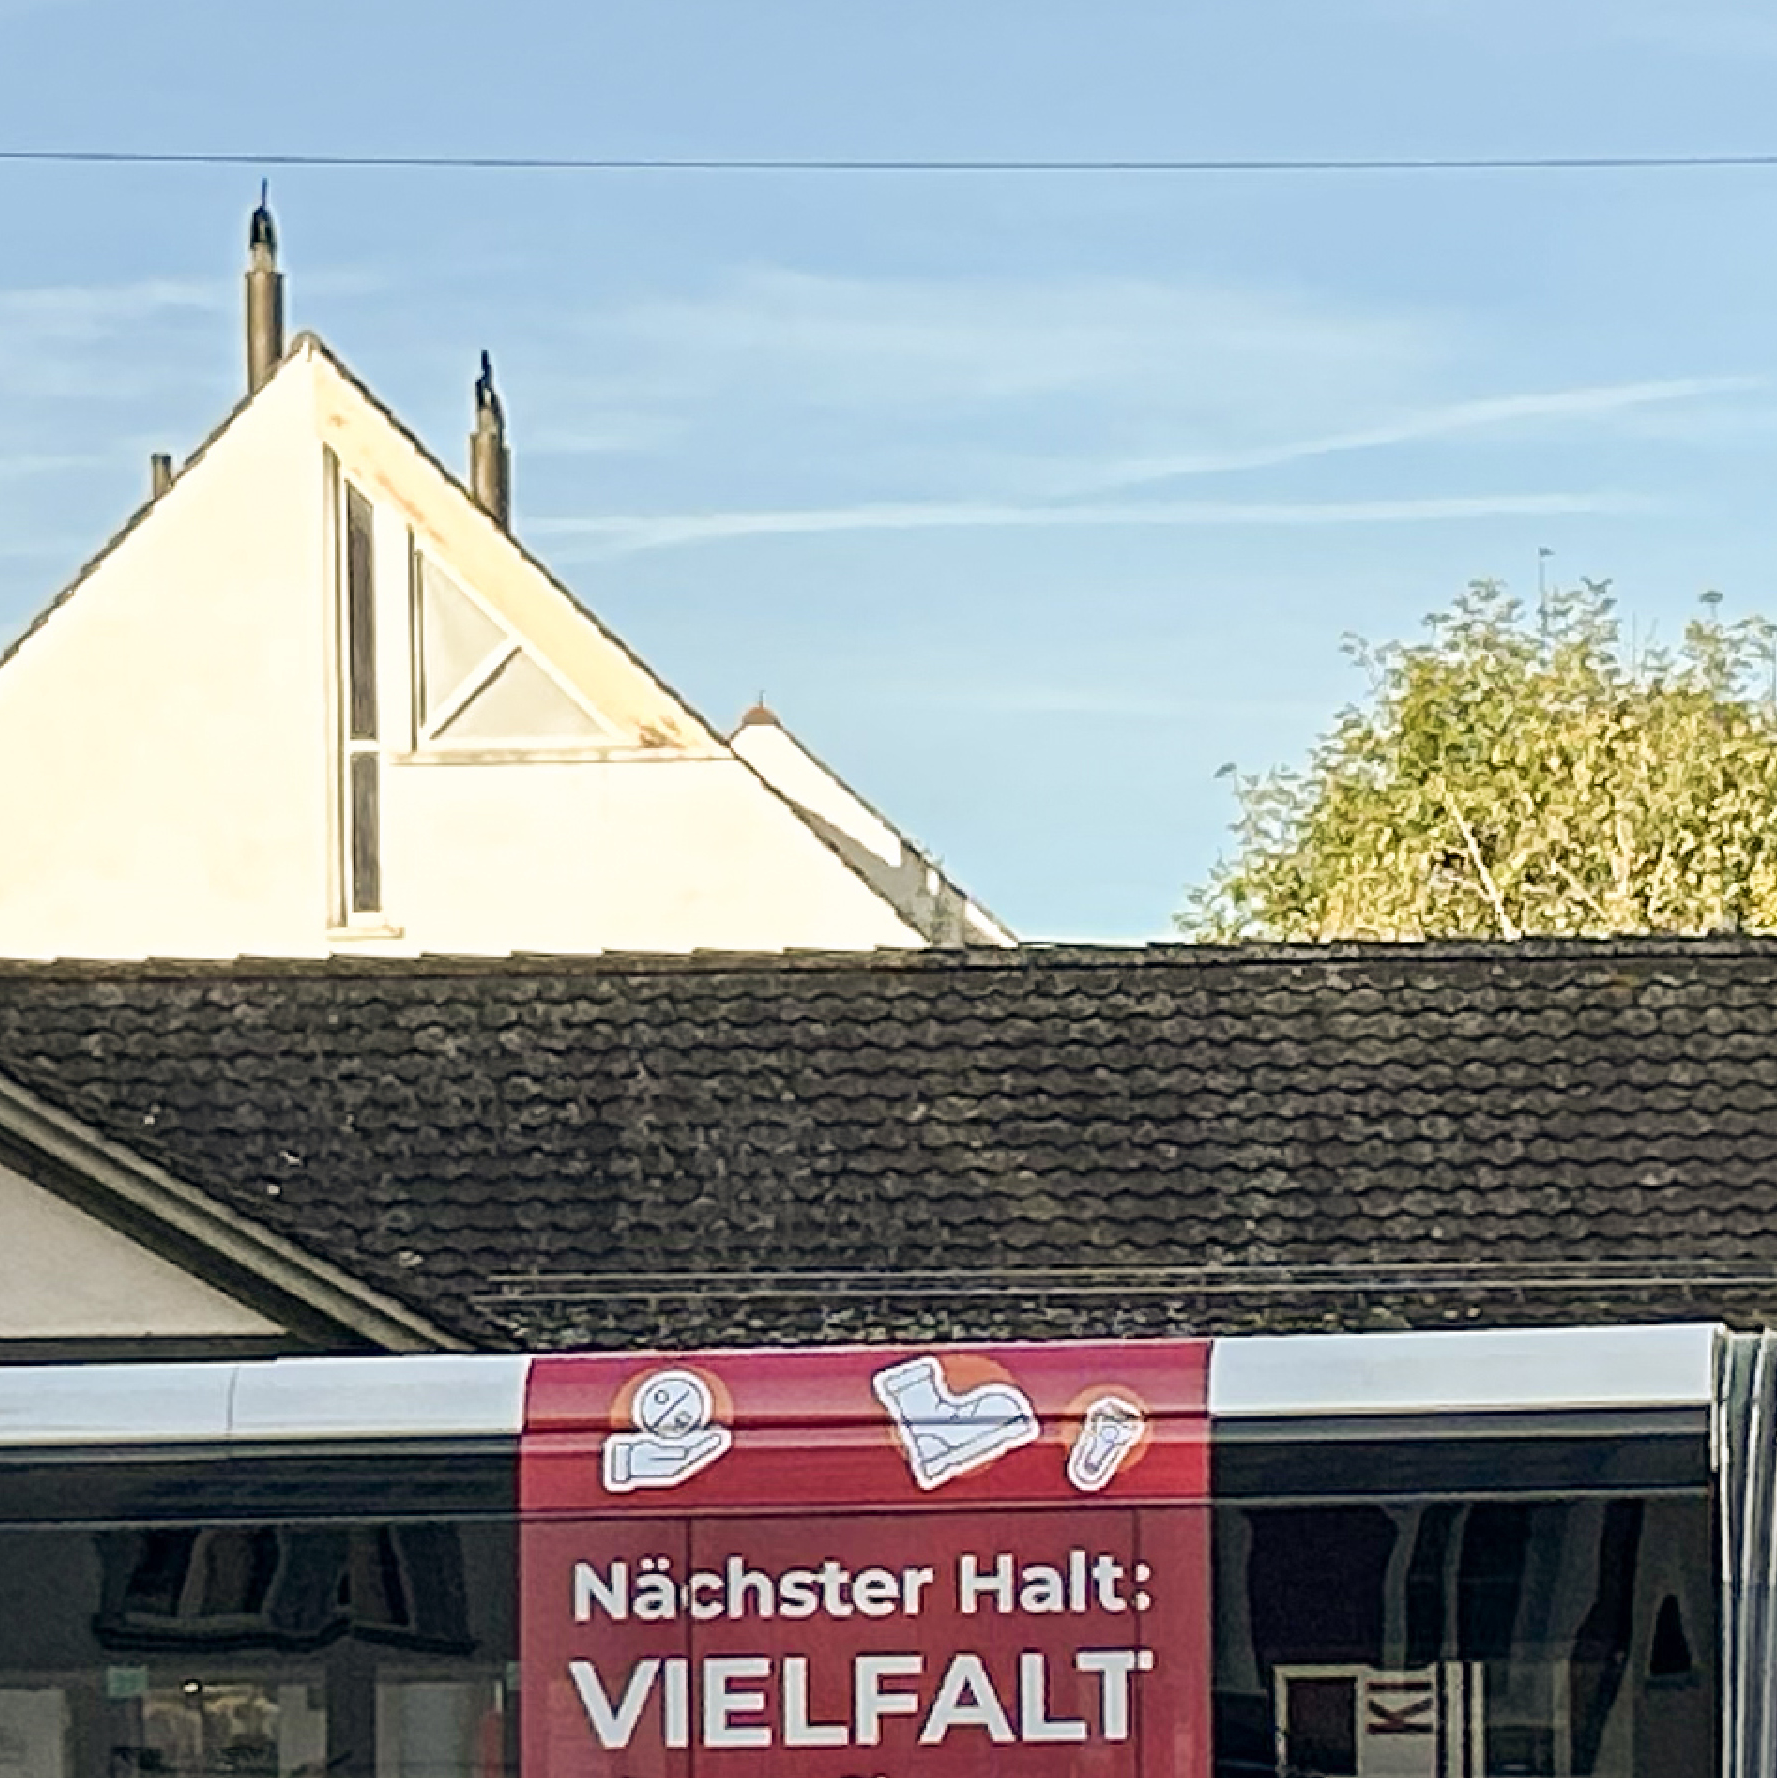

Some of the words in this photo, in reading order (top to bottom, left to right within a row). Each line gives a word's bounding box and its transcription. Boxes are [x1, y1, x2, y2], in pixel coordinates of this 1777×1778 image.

[573, 1555, 934, 1622] Nächster
[960, 1548, 1153, 1614] Halt:
[567, 1649, 1155, 1749] VIELFALT
